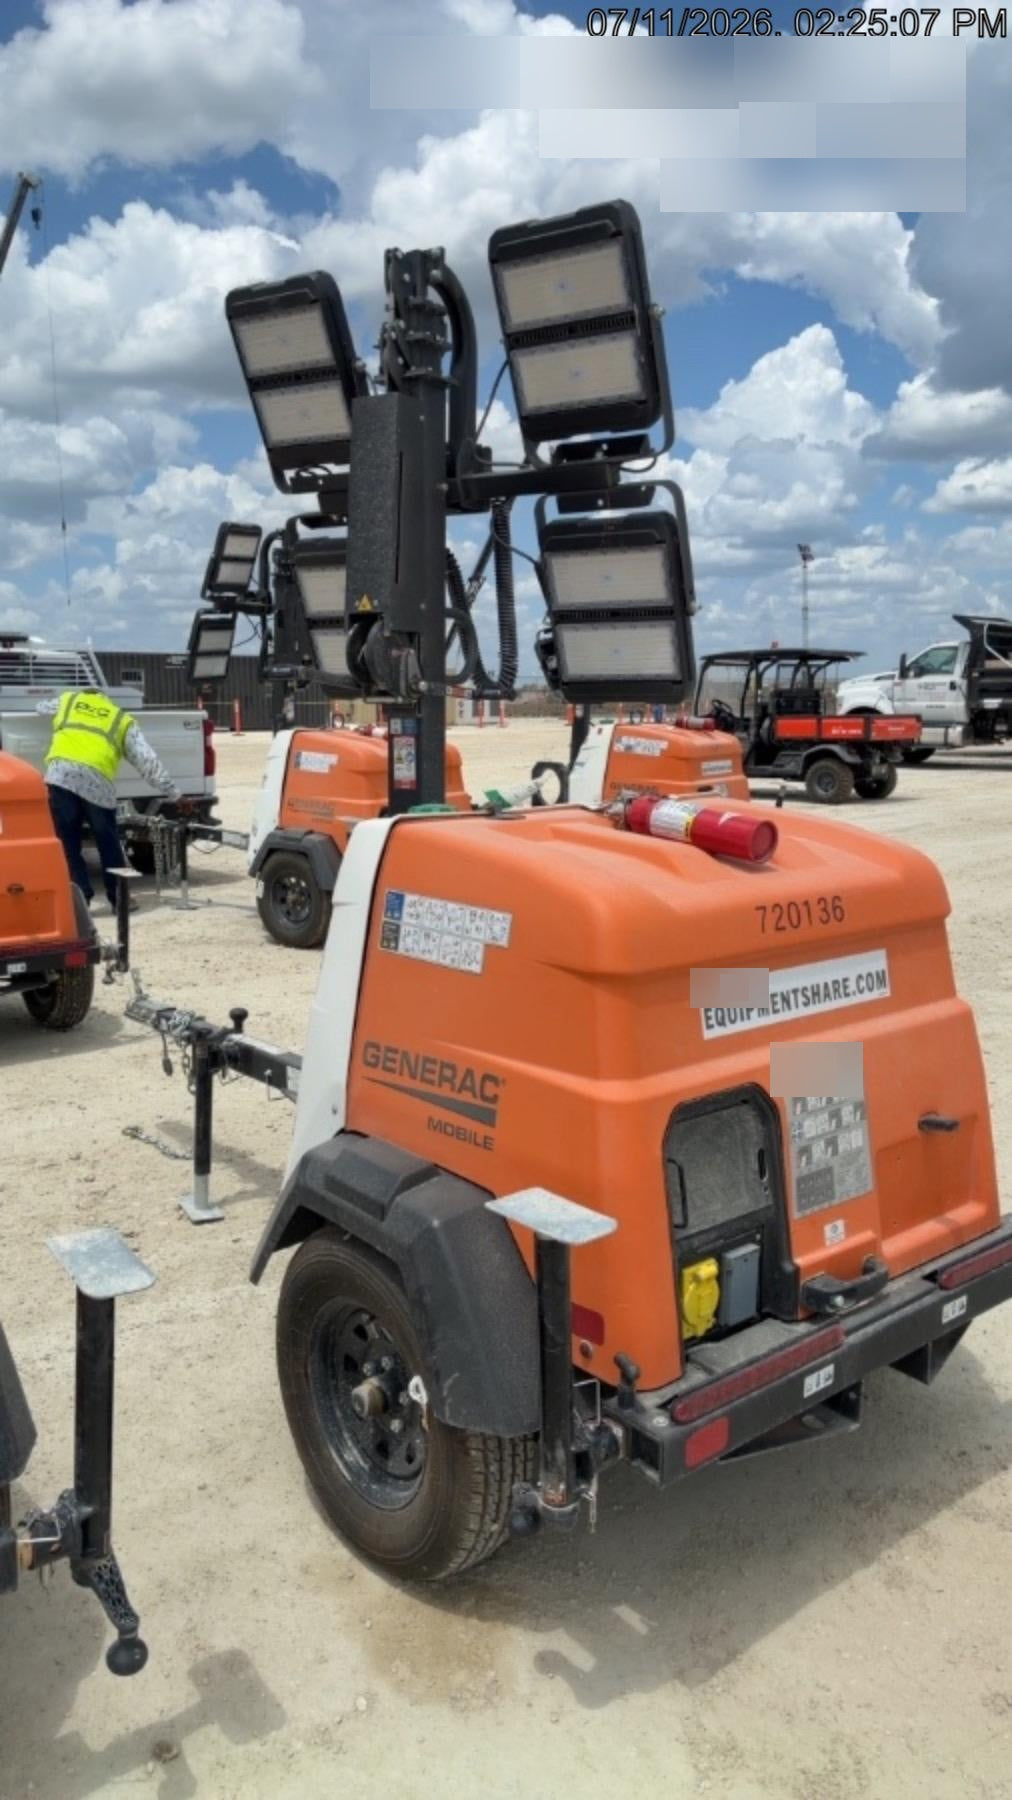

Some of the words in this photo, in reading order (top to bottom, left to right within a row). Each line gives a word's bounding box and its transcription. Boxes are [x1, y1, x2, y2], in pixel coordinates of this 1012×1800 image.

[755, 896, 845, 933] 720136
[363, 1040, 499, 1104] GENERAC
[427, 1116, 496, 1150] MOBILE
